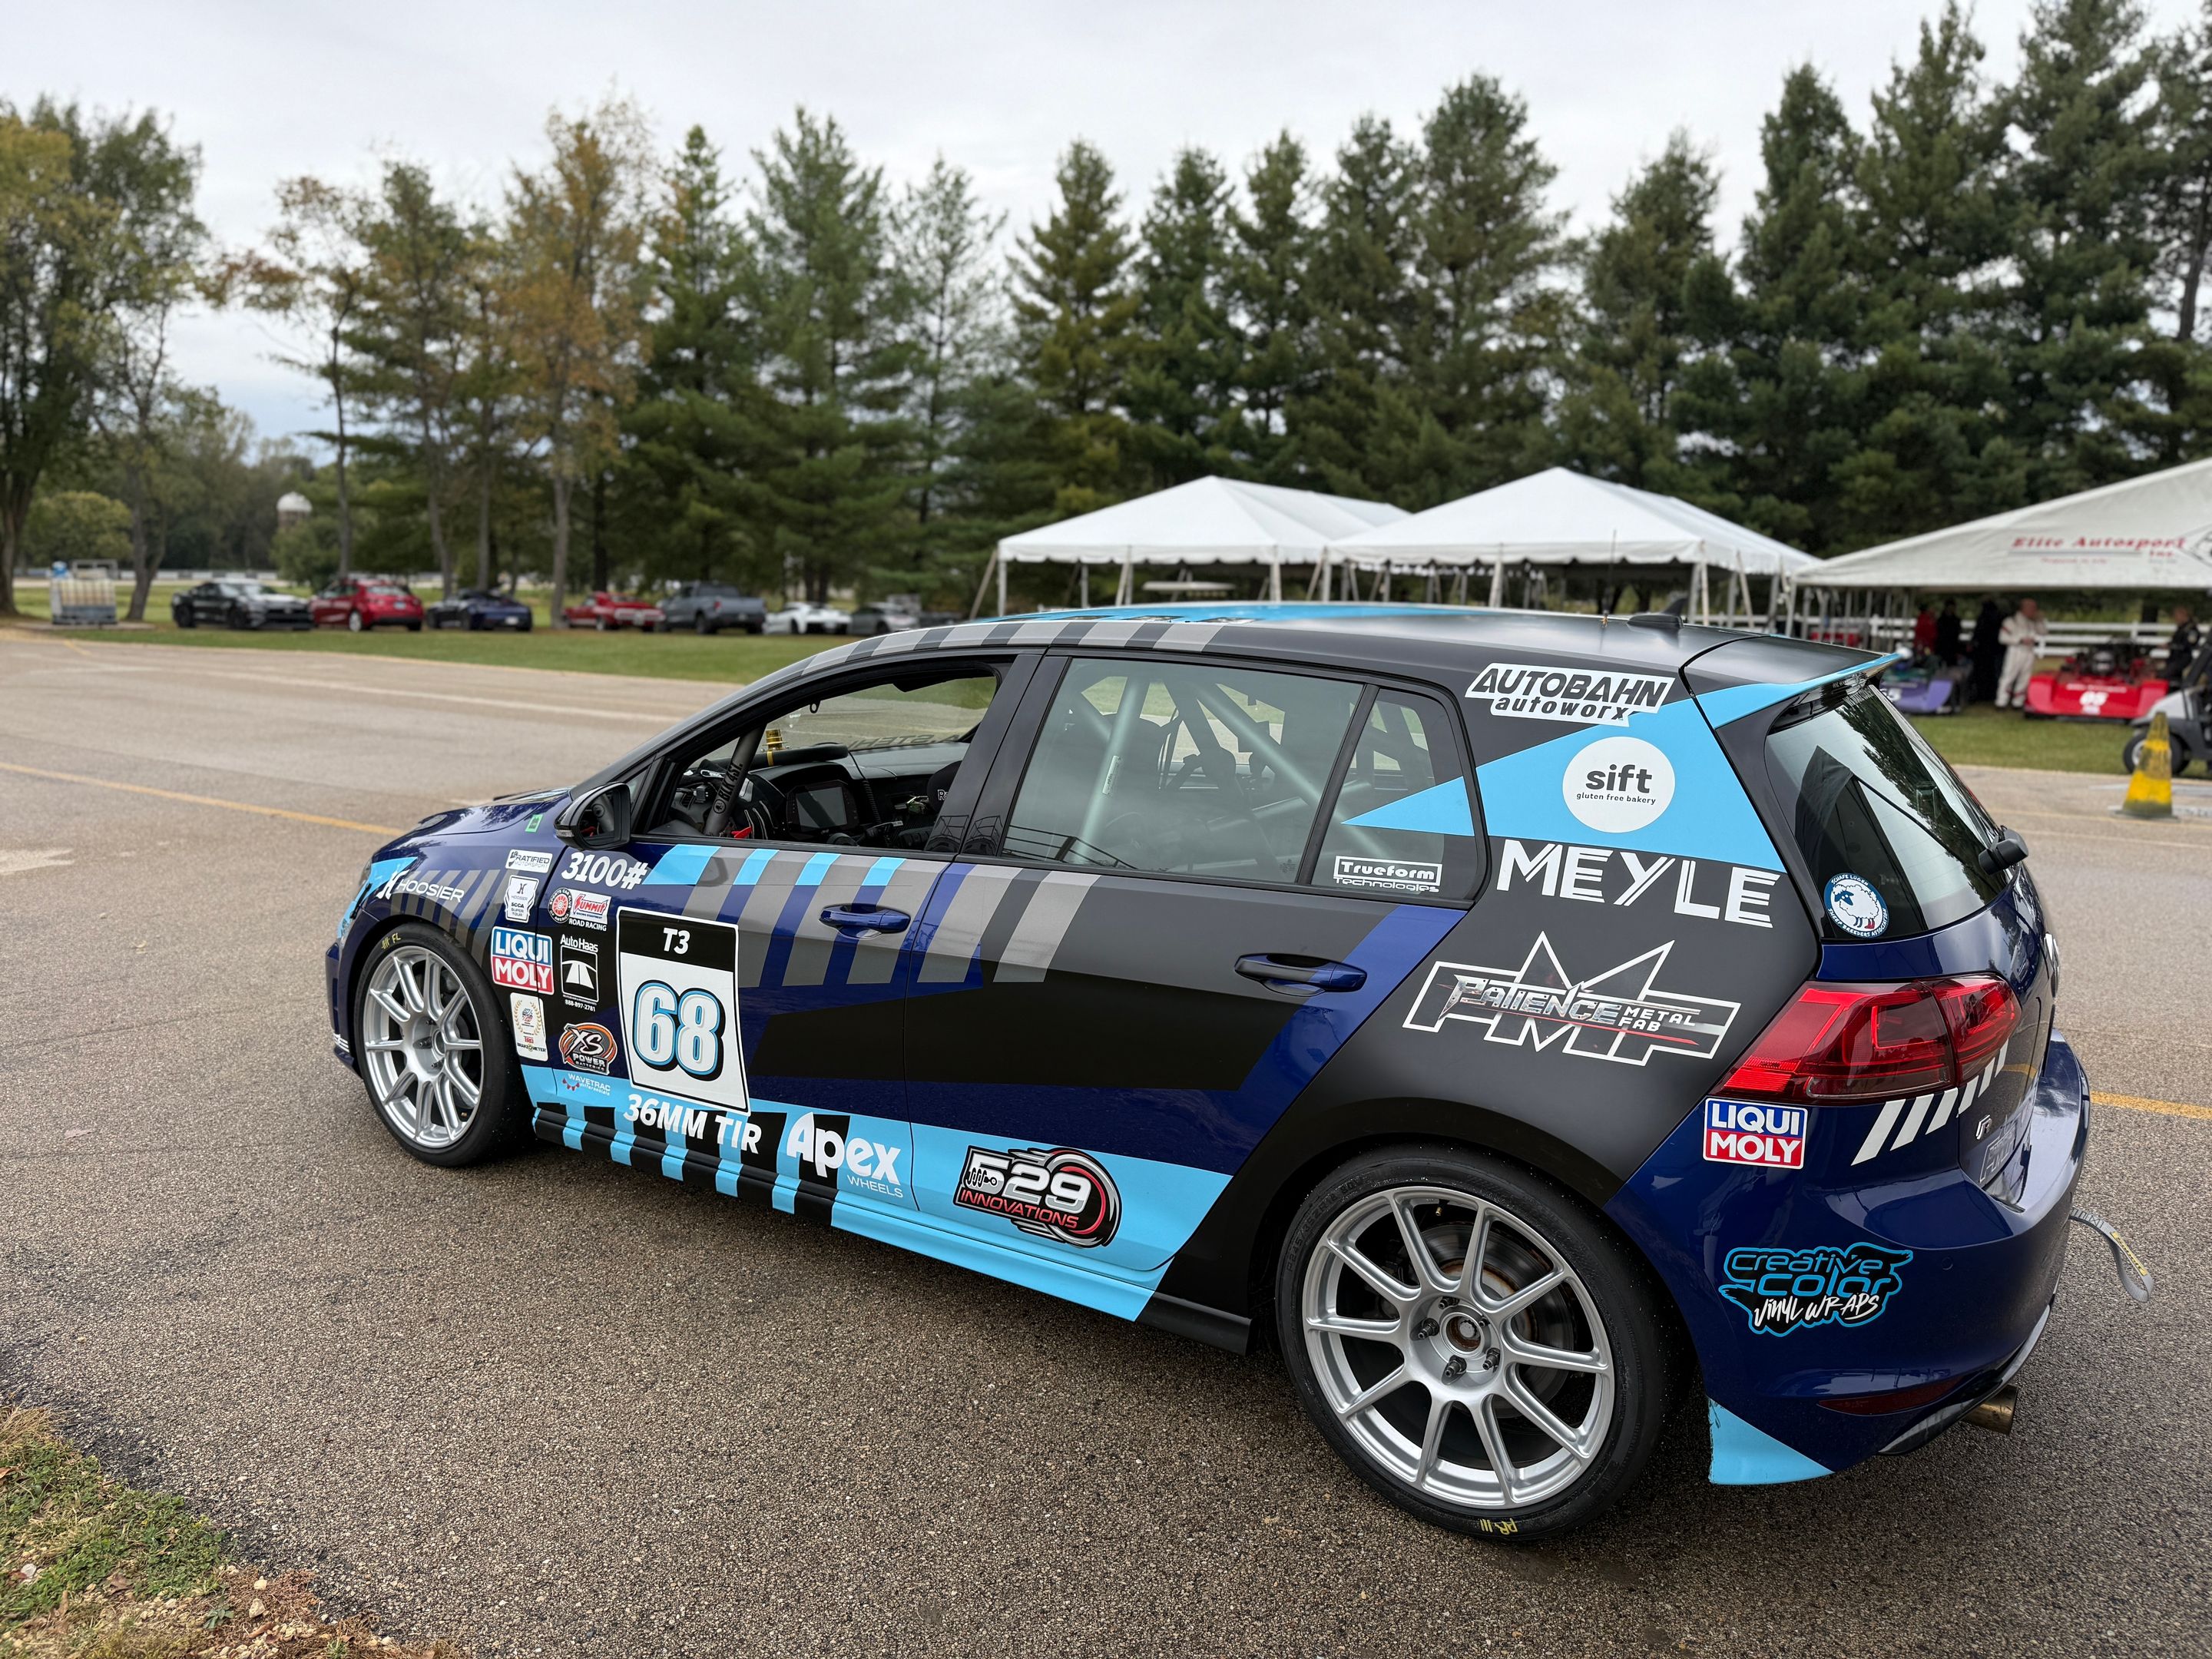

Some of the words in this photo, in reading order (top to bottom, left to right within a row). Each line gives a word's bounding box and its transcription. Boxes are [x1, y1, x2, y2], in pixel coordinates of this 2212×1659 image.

[2012, 537, 2064, 548] Elite
[2073, 535, 2187, 551] Autosport
[1471, 667, 1667, 707] AUTOBAHN
[1495, 696, 1630, 721] autoworx
[1585, 763, 1653, 794] sift
[1576, 792, 1604, 801] gluten
[1607, 793, 1624, 802] free
[1626, 795, 1657, 806] bakery
[561, 852, 649, 890] 3100#
[1341, 861, 1435, 880] Trueform
[396, 879, 465, 903] HOOSIER
[1333, 877, 1439, 893] Technologies
[1496, 839, 1781, 929] MEYLE
[575, 894, 605, 913] SUMMIT
[569, 918, 585, 927] ROAD
[585, 920, 607, 932] RACING
[1843, 925, 1870, 937] BREEDERS
[495, 931, 548, 963] LIQUI
[663, 927, 690, 955] T3
[495, 958, 551, 989] MOLY
[1438, 974, 1622, 1025] PATIENCE
[1618, 1018, 1662, 1032] FAB
[1623, 1005, 1697, 1027] METAL
[633, 981, 724, 1078] 68
[565, 1027, 604, 1058] XS
[572, 1052, 606, 1068] POWER
[576, 1061, 605, 1071] BATTERIES
[568, 1073, 611, 1091] WAVETRAC
[622, 1093, 708, 1141] 36MM
[714, 1116, 763, 1155] TIR
[1711, 1102, 1800, 1136] LIQUI
[786, 1111, 902, 1186] Apex
[1710, 1131, 1801, 1164] MOLY
[846, 1175, 905, 1199] WHEELS
[963, 1152, 1092, 1214] 529
[960, 1189, 1080, 1229] INNOVATIONS
[1731, 1253, 1883, 1275] creative
[1757, 1273, 1892, 1298] color
